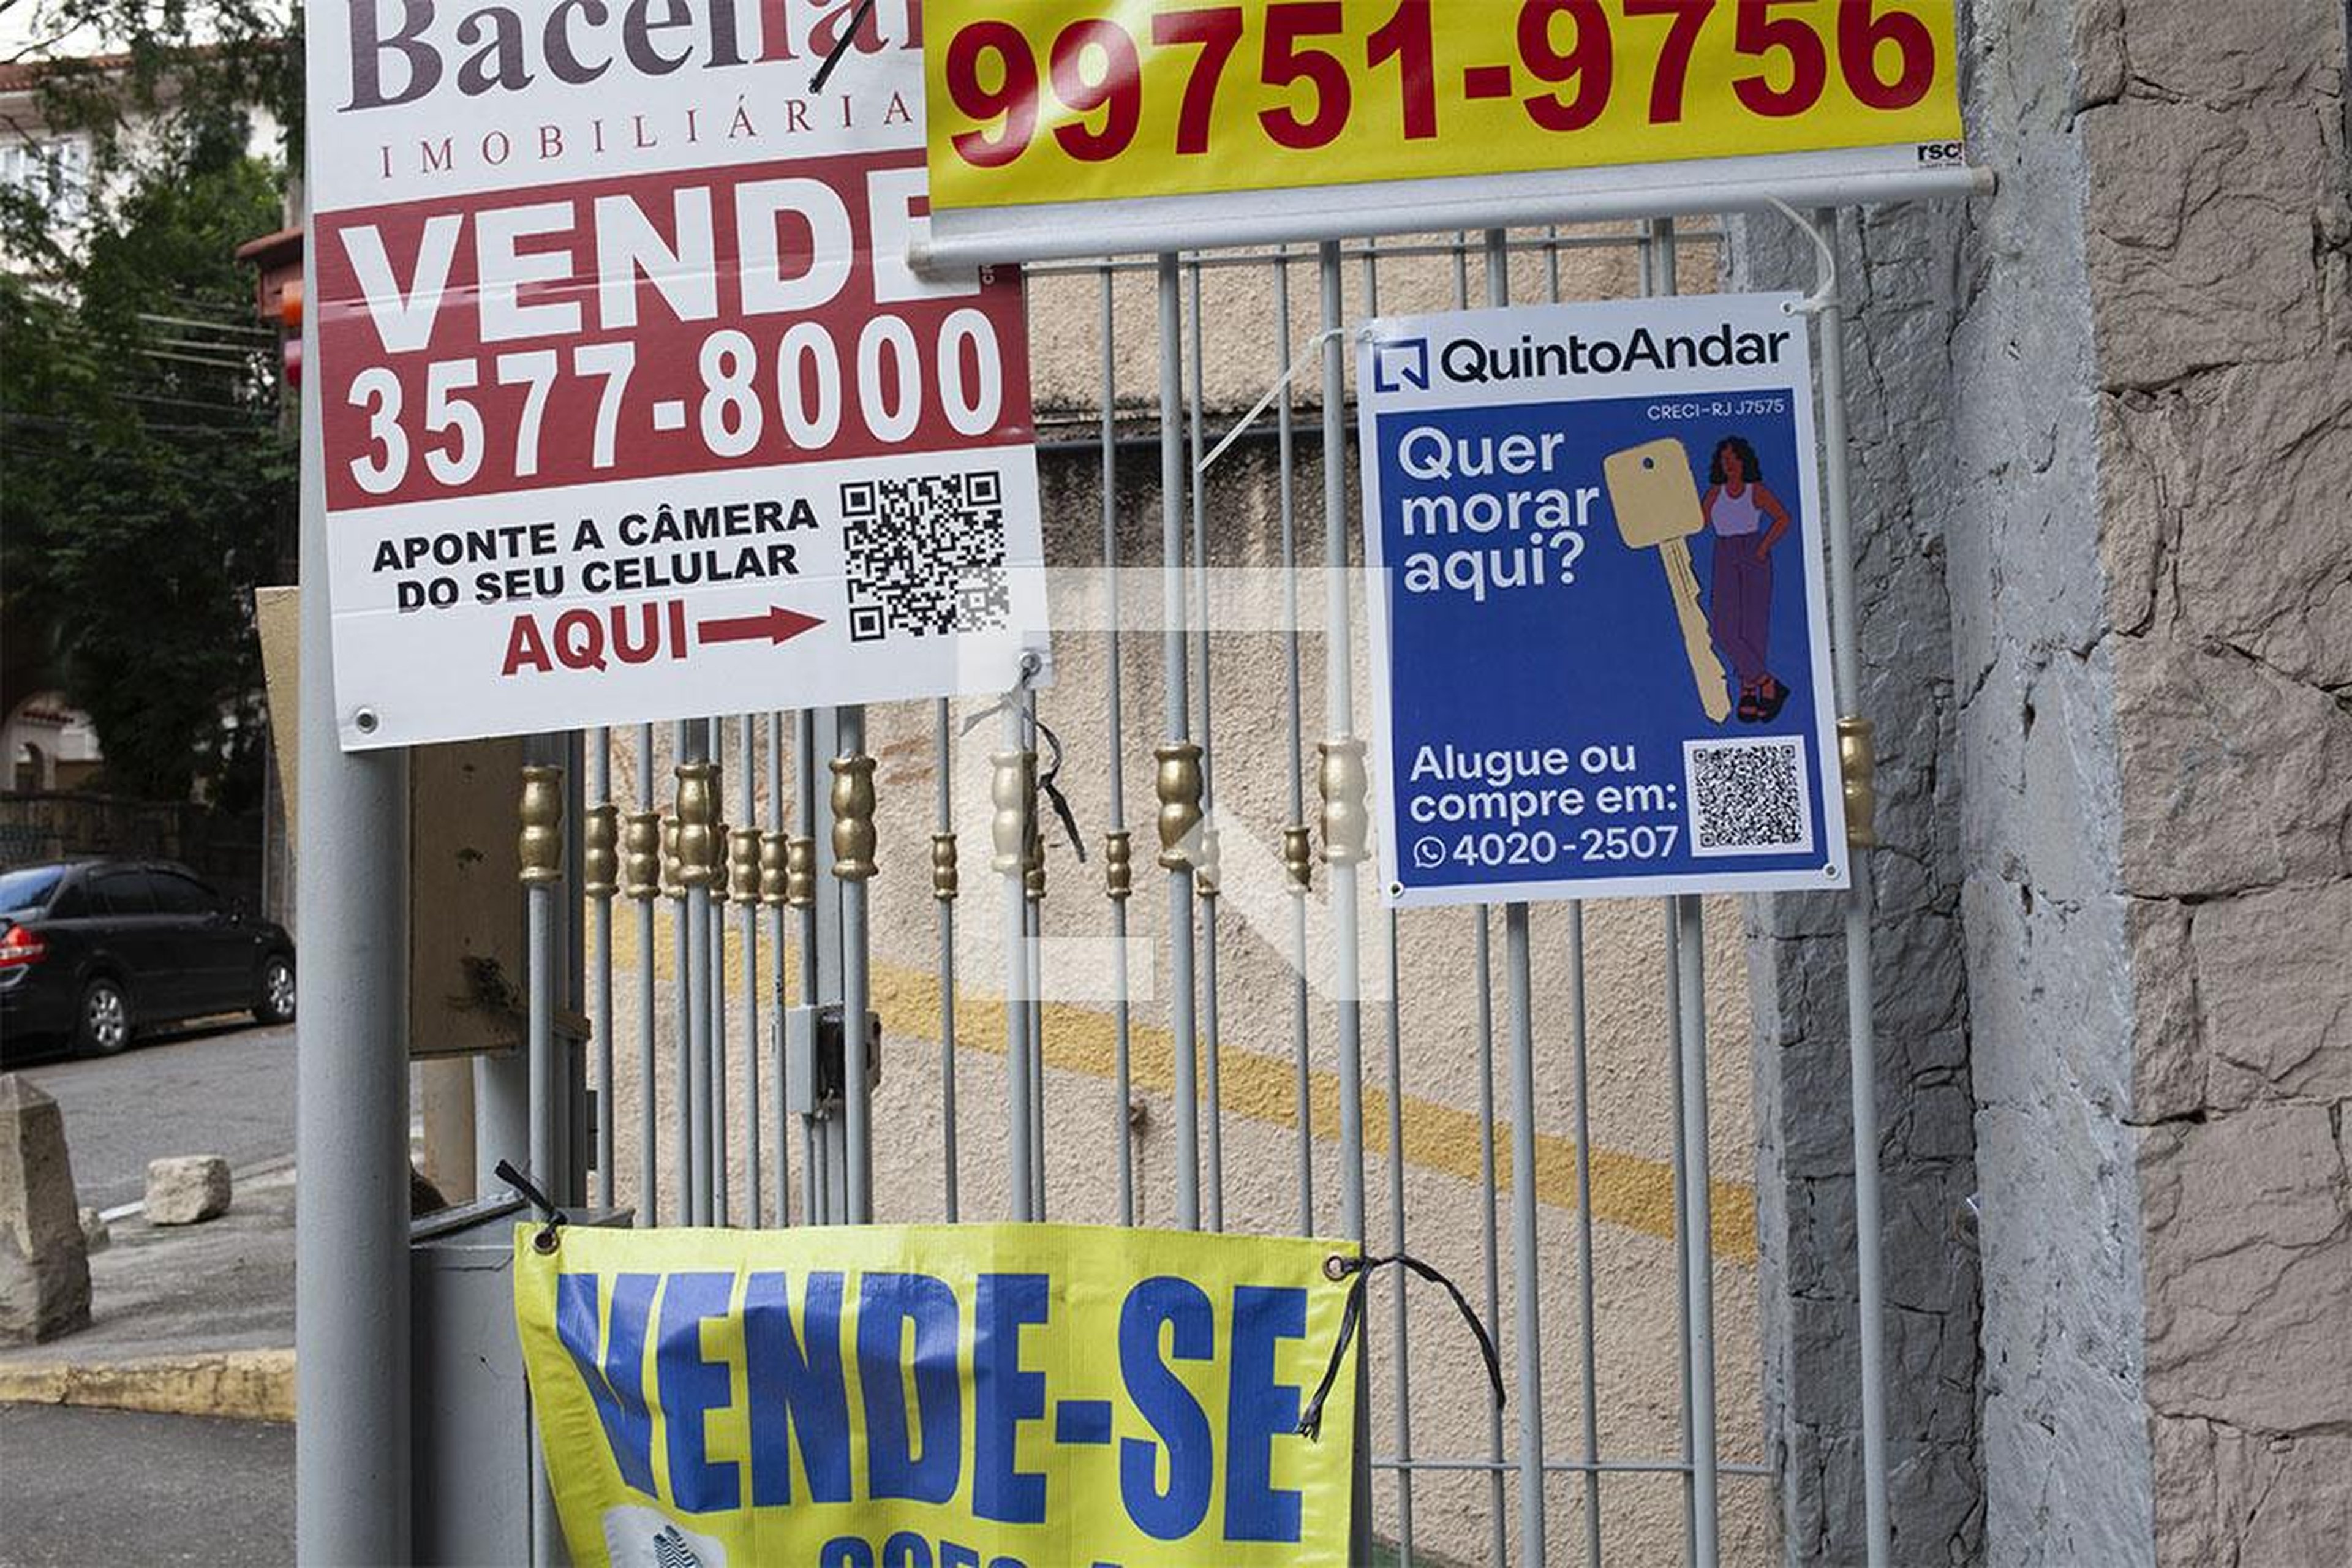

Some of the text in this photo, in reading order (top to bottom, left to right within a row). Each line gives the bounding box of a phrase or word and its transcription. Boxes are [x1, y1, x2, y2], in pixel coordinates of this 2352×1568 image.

[337, 0, 923, 112] Bacea
[946, 0, 1936, 168] 99751-9756
[381, 91, 913, 178] IMOBILIÁRIA
[339, 167, 980, 353] VENDE
[1441, 323, 1790, 385] QuintoAndar
[344, 309, 1003, 494] 3577-8000
[1647, 399, 1784, 420] CRECI-RJ J7575
[1398, 427, 1564, 480] Quer
[373, 497, 819, 572] APONTE A CÂMERA
[1402, 486, 1599, 536] morar
[398, 543, 799, 612] DO SEU CELULAR
[1404, 532, 1585, 601] aqui?
[501, 600, 687, 676] AQUI
[1410, 742, 1637, 786] Alugue ou
[1410, 780, 1677, 826] compre em:
[1453, 826, 1678, 866] 4020-2507
[556, 1270, 1308, 1542] VENDE-SE
